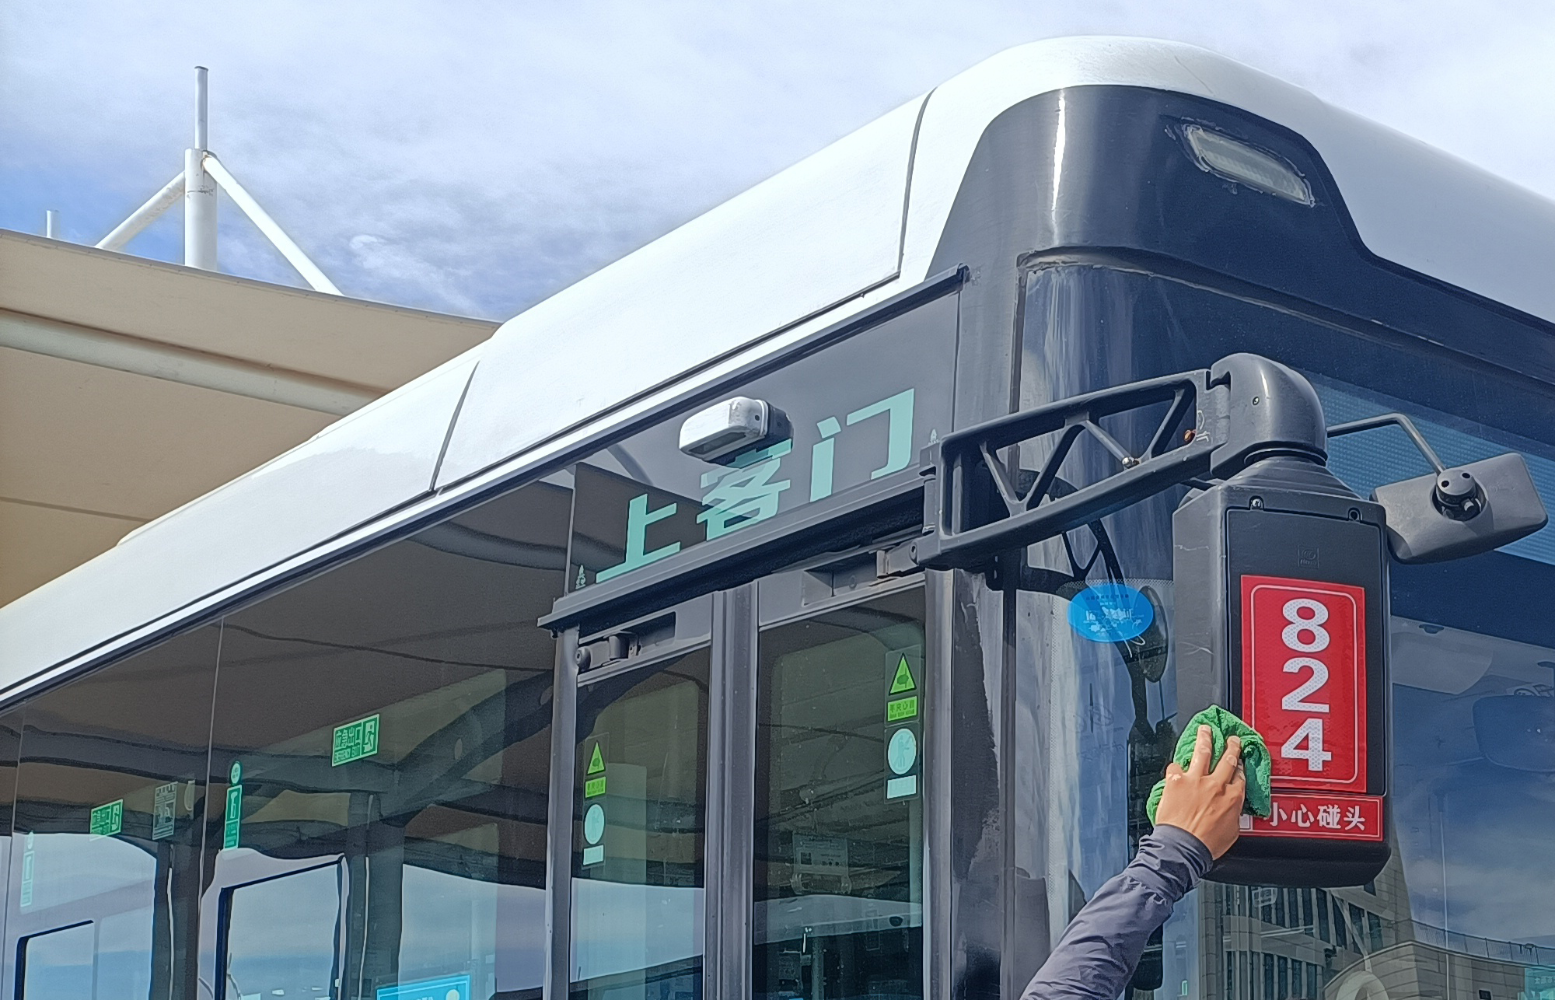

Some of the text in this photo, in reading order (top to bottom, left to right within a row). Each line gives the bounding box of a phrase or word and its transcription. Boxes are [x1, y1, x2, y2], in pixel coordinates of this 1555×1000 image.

[596, 388, 914, 583] 上客门
[1281, 598, 1332, 772] 824
[1263, 801, 1366, 831] 小心碰头
